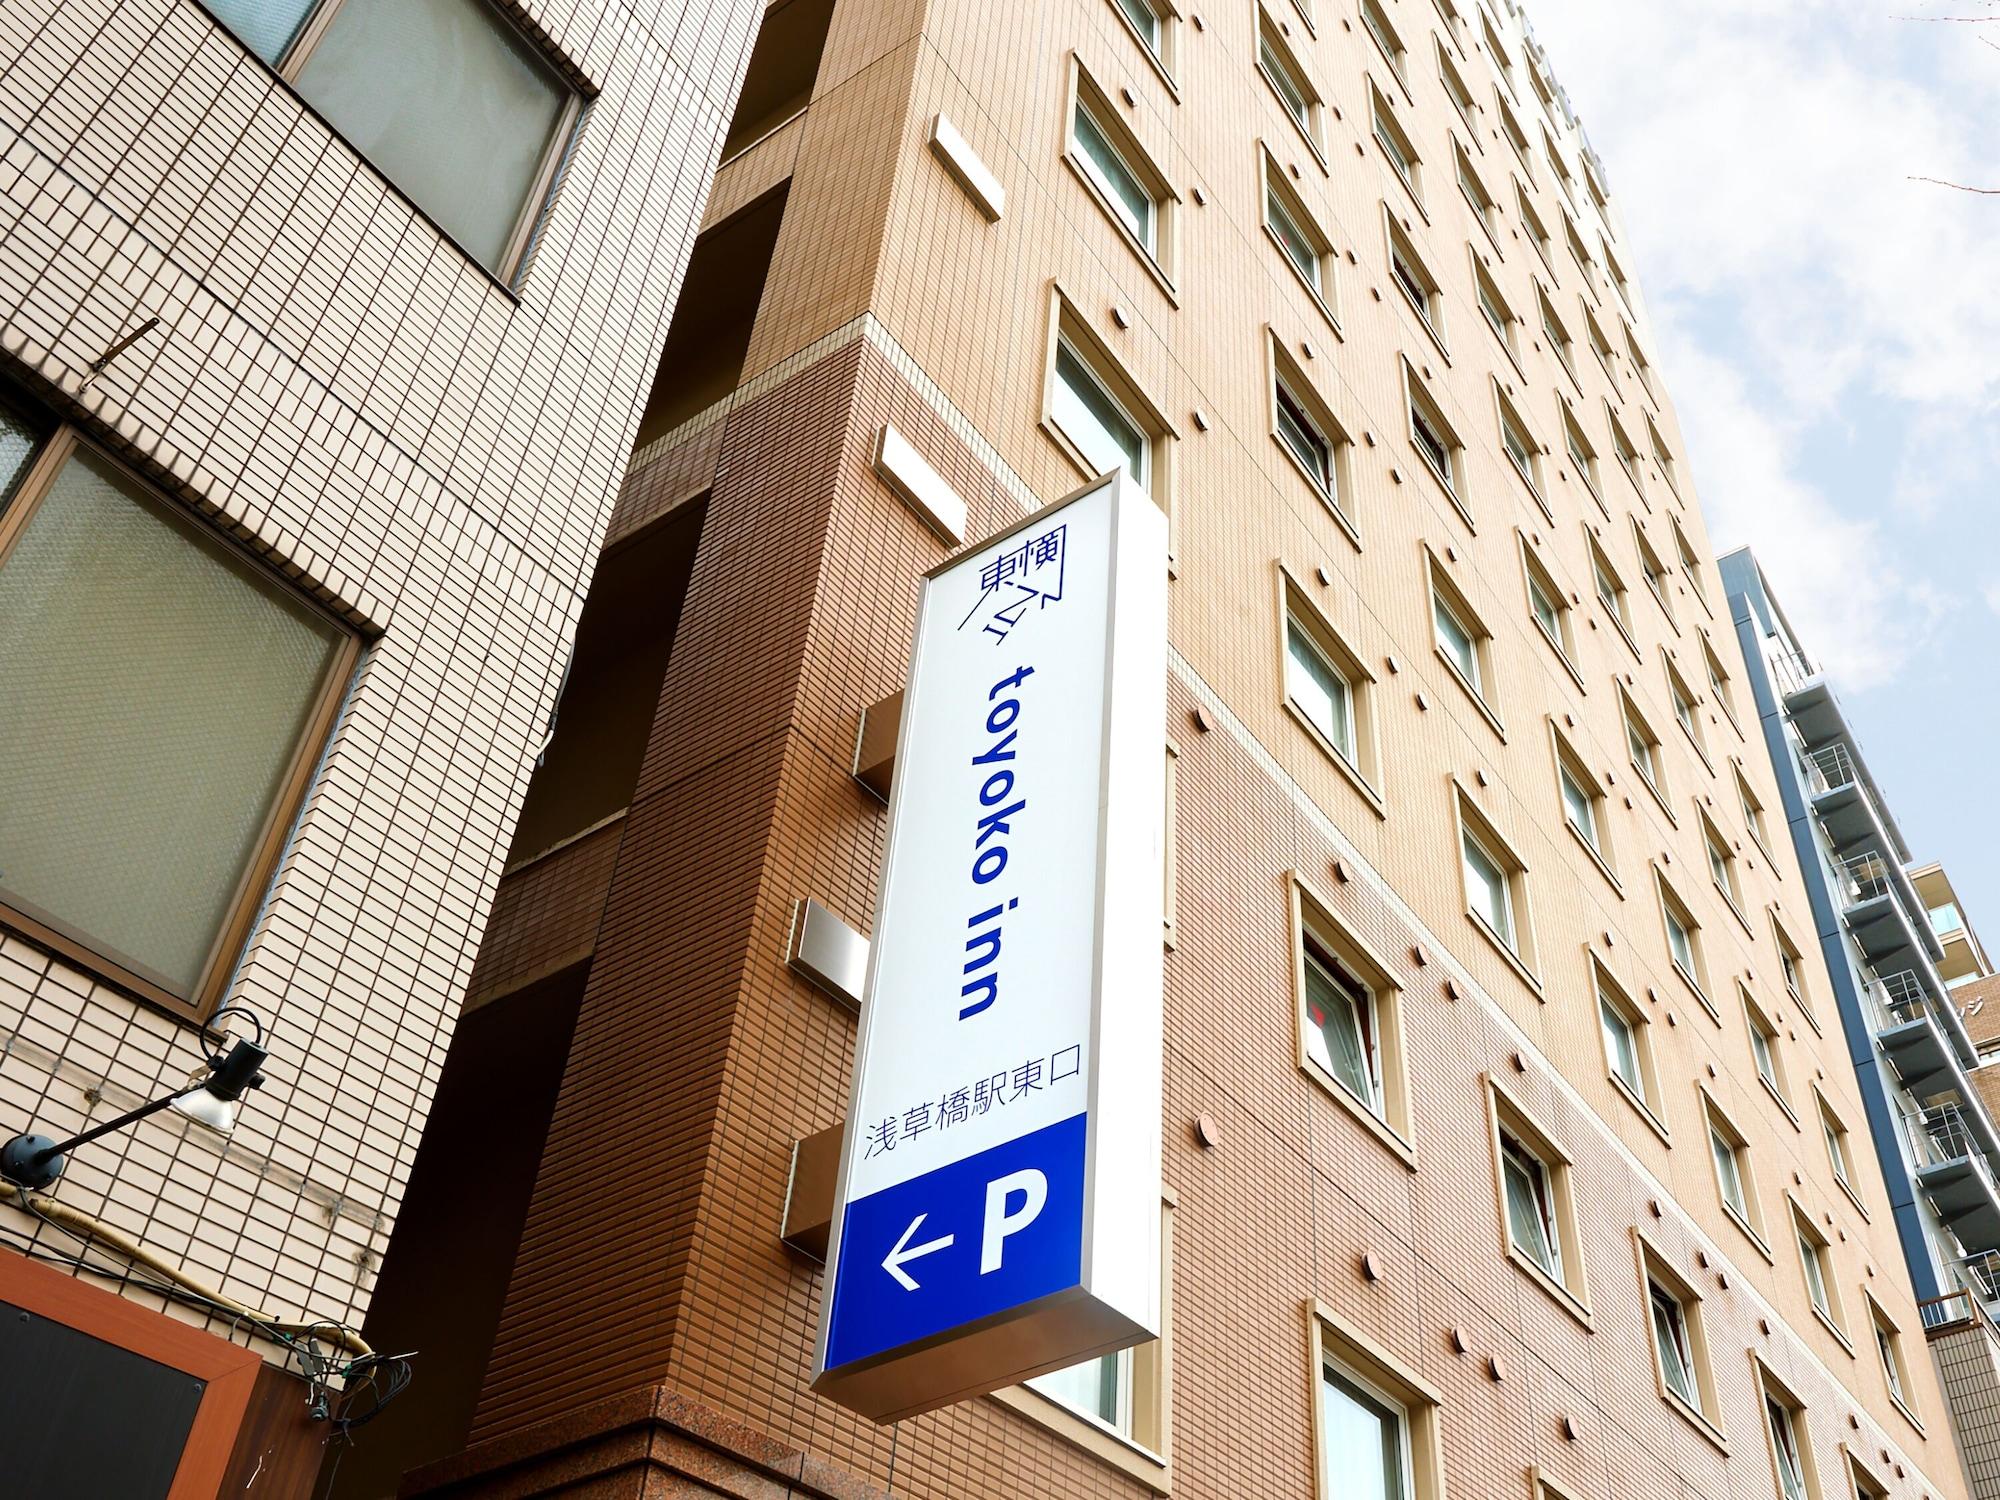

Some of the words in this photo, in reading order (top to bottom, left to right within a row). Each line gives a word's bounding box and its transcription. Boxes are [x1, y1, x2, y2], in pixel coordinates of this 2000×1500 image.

[972, 665, 1036, 885] toyoko
[958, 896, 1019, 1022] inn
[864, 1044, 1081, 1160] 浅草橋駅東口
[980, 1168, 1048, 1275] P
